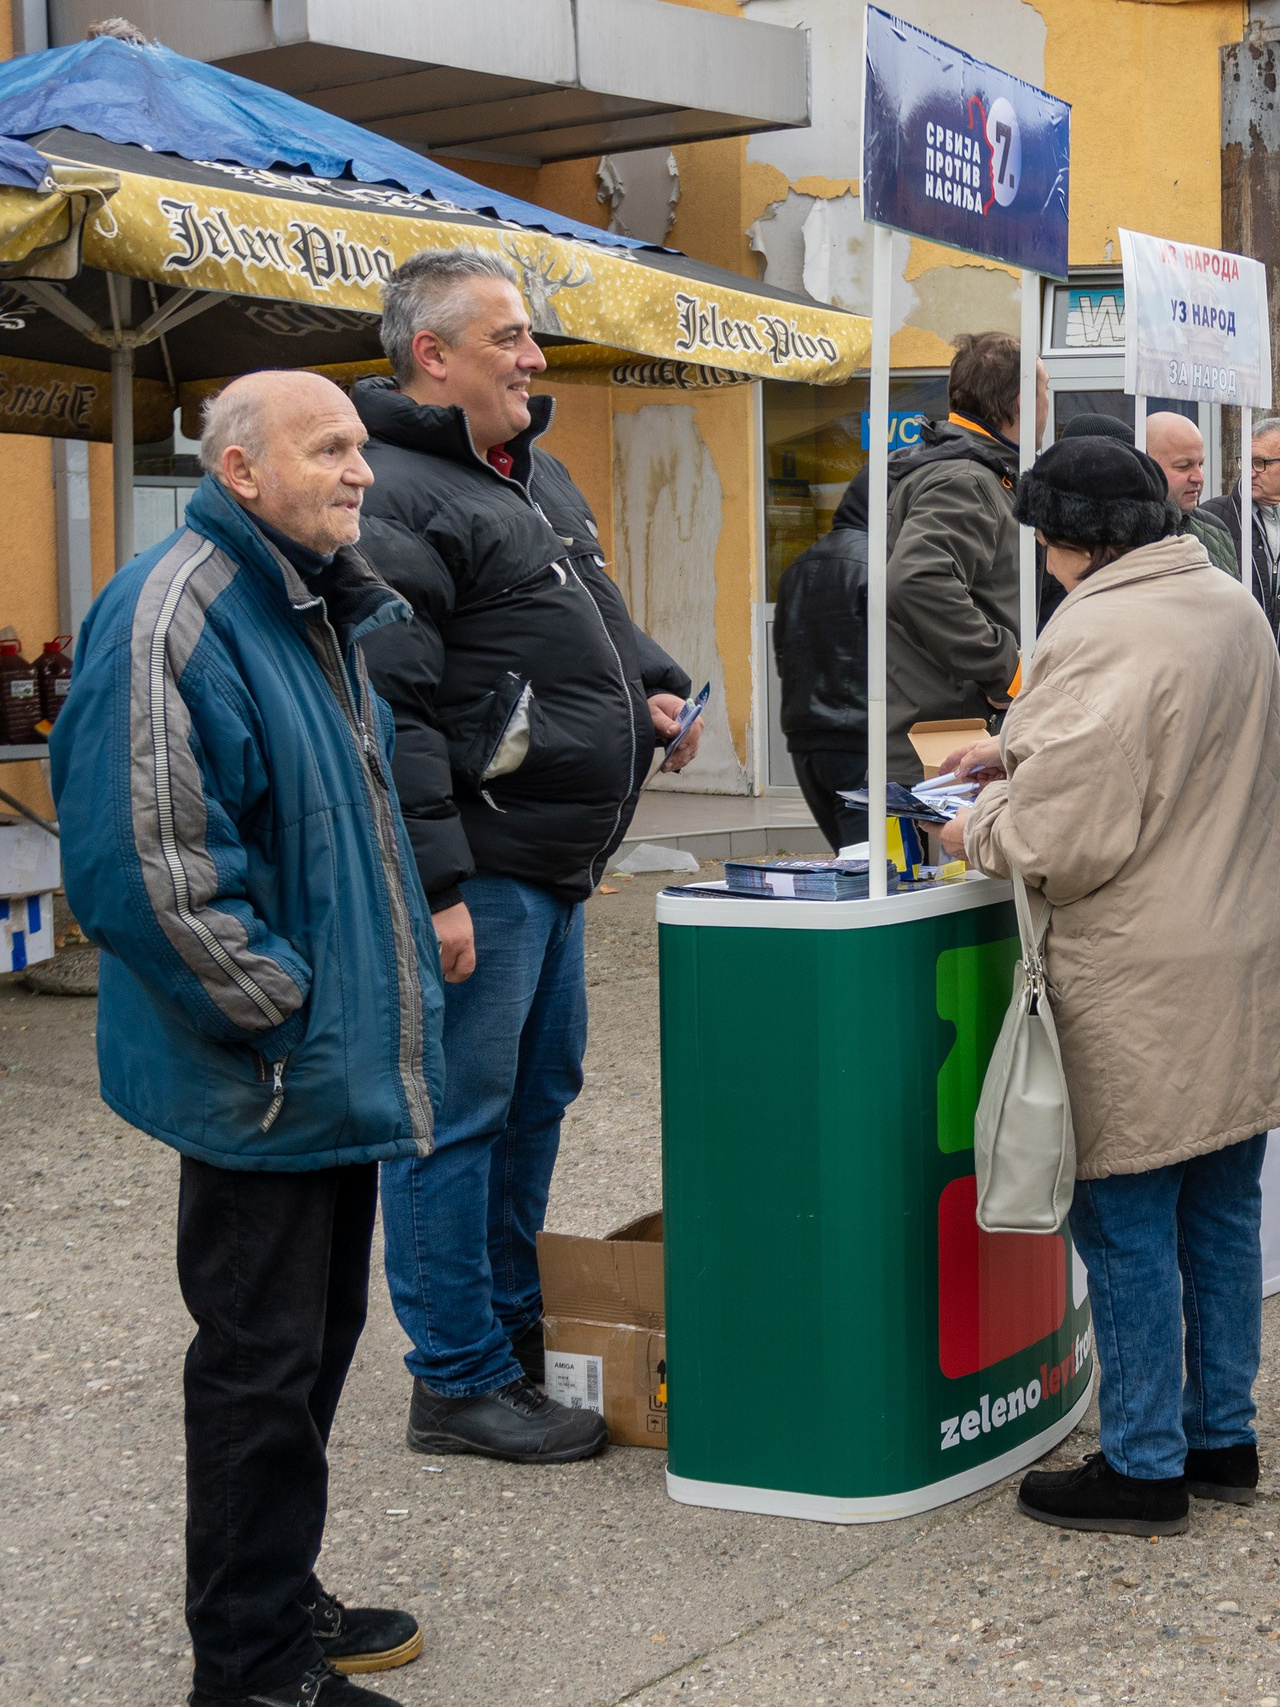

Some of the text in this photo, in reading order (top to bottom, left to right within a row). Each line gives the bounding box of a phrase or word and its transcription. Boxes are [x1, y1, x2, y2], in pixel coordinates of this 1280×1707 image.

[926, 121, 981, 164] СРБИЈА
[995, 120, 1015, 189] 7.
[925, 146, 981, 188] ПРОТИВ
[925, 172, 983, 215] НАСИЉА
[157, 196, 297, 276] Jelen
[288, 219, 397, 292] Pivo
[1184, 250, 1240, 283] НАРОДА
[675, 292, 840, 367] Jelen Pivo
[1171, 299, 1236, 337] УЗ НАРОД
[1169, 360, 1237, 397] ЗА НАРОД
[554, 1362, 575, 1370] AMIGA
